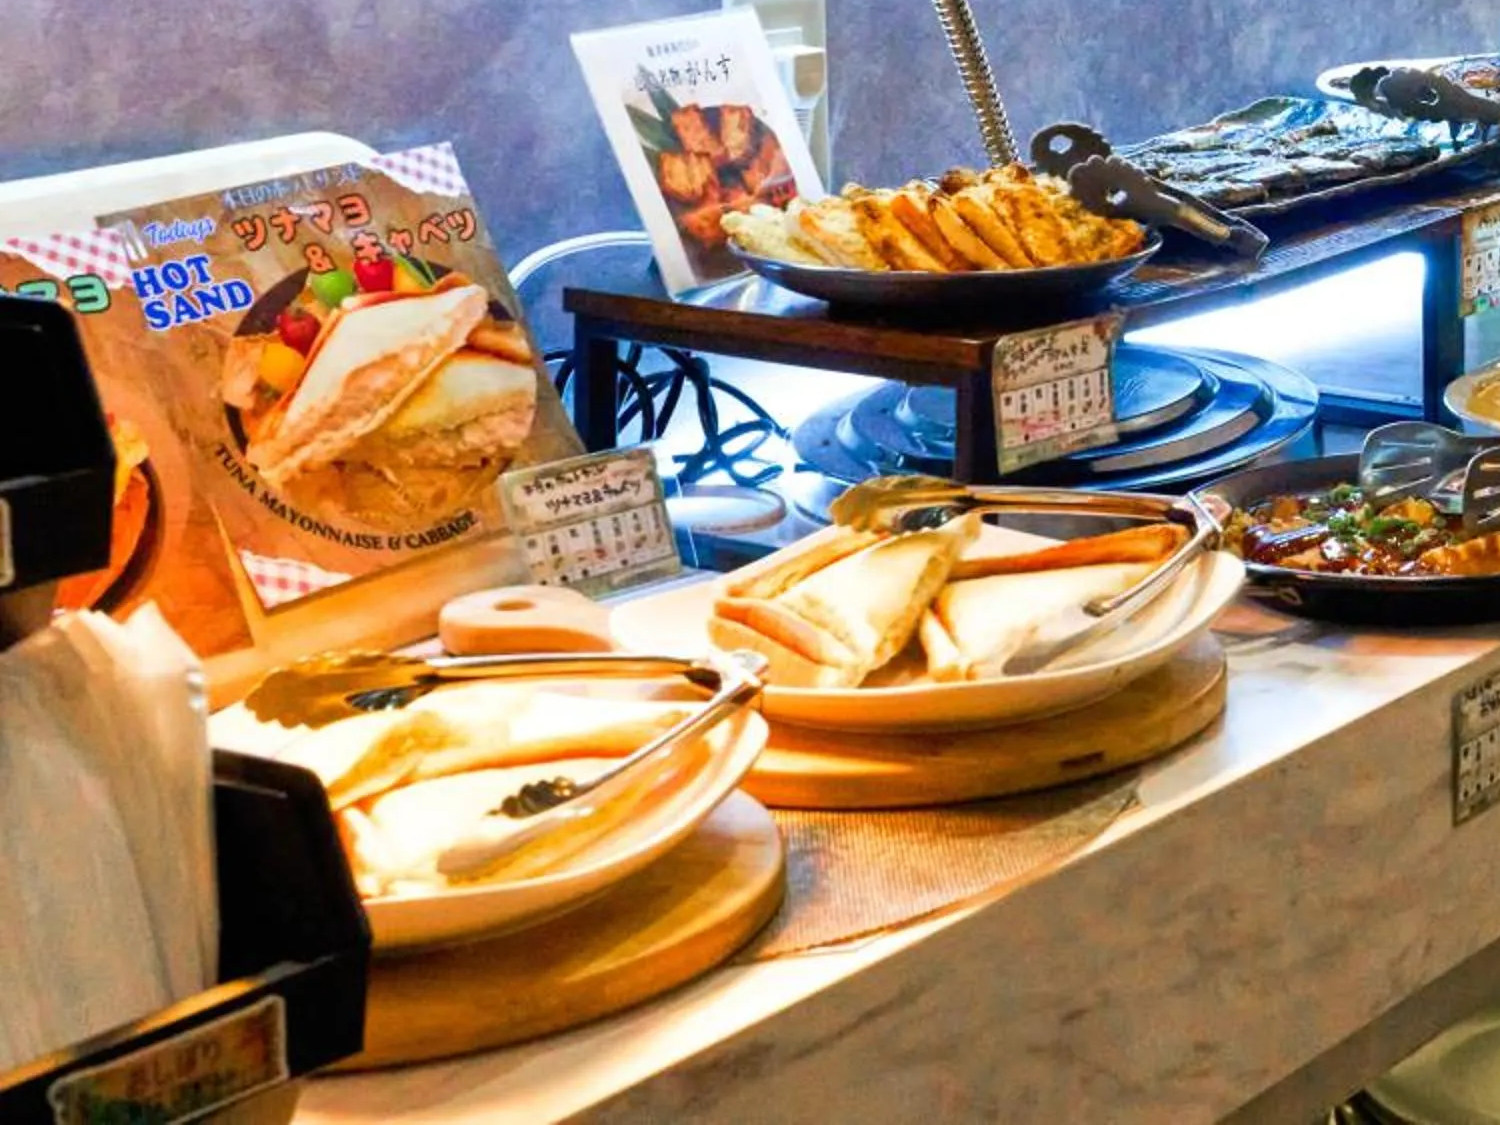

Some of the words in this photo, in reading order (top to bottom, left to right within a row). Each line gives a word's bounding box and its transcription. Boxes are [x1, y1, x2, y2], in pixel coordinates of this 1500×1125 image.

[231, 193, 371, 252] ツナマヨ
[303, 242, 336, 274] &
[351, 206, 477, 266] キャベツ
[131, 254, 212, 300] HOT
[143, 277, 253, 332] SAND
[215, 443, 257, 495] TUNA
[258, 489, 384, 551] MAYONNAISE
